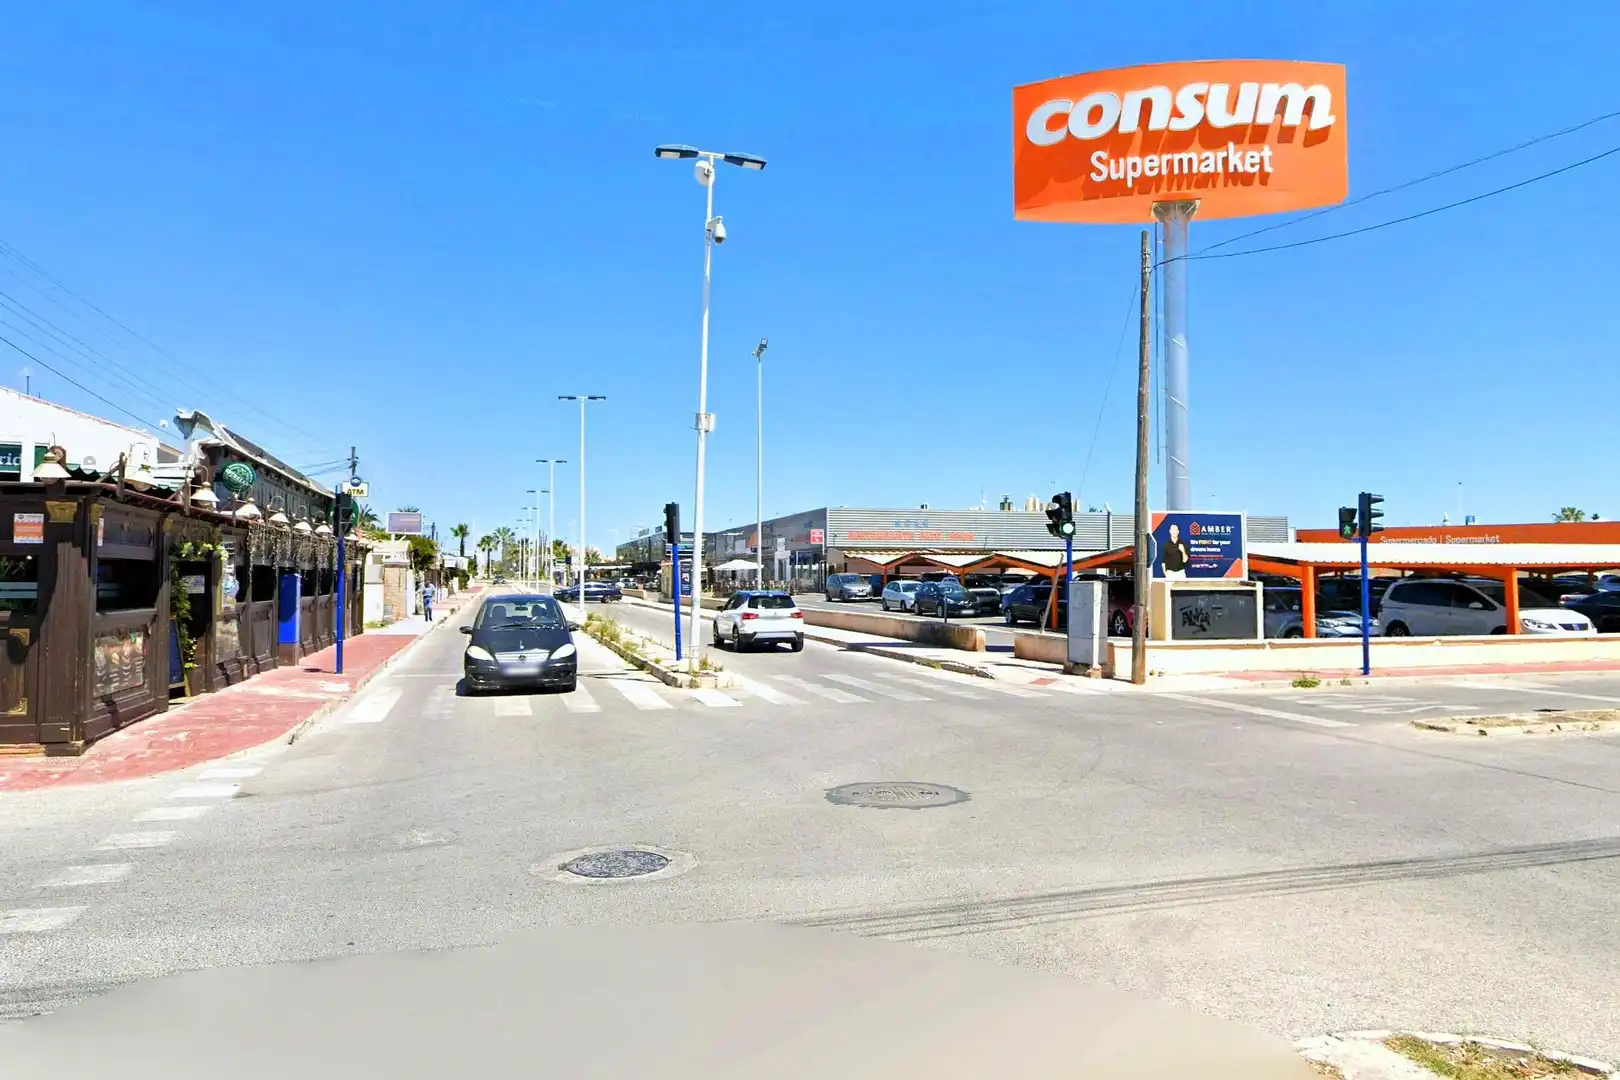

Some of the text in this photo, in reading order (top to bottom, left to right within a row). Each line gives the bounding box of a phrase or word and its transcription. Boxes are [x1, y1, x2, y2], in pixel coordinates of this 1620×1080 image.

[1026, 82, 1336, 147] consum
[1090, 142, 1273, 187] Supermarket
[1201, 525, 1231, 533] AMBER
[1445, 534, 1500, 544] Supermarket
